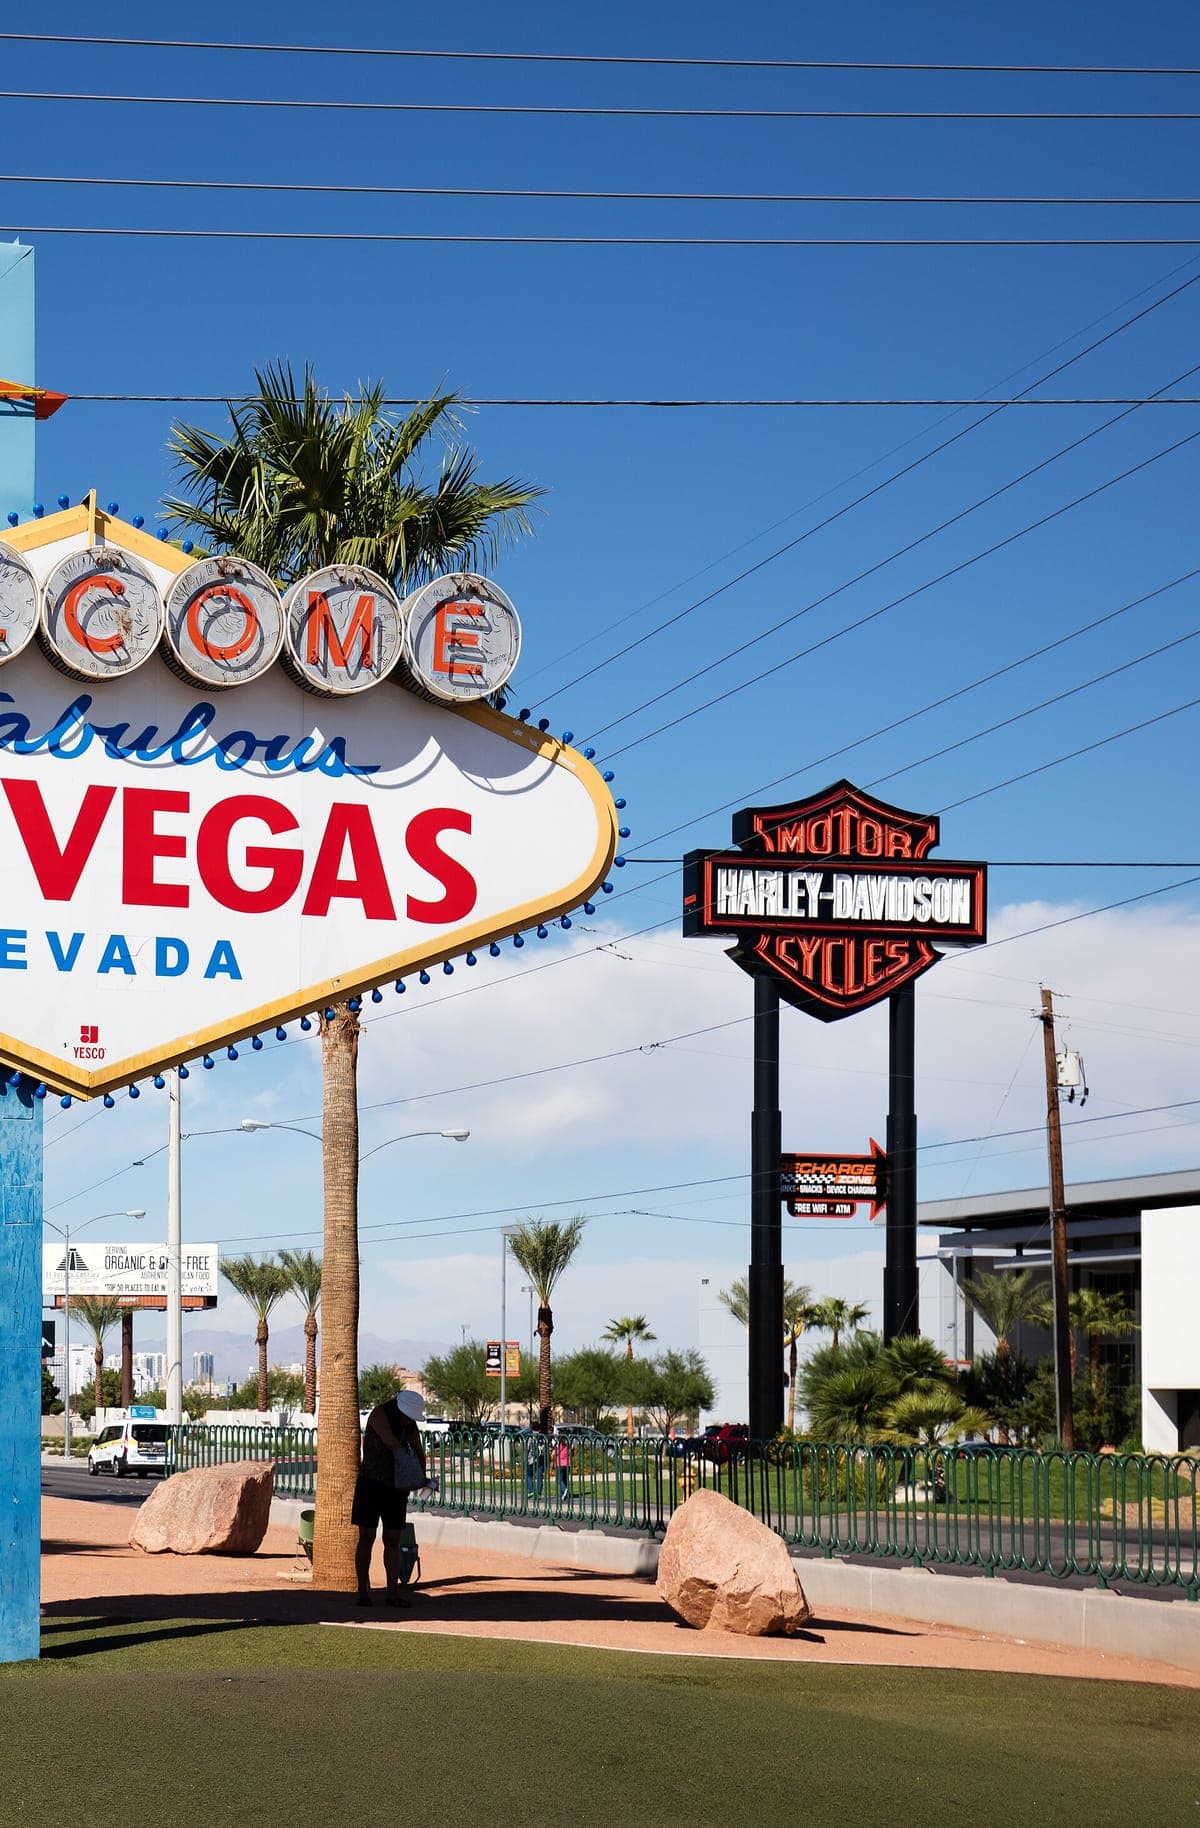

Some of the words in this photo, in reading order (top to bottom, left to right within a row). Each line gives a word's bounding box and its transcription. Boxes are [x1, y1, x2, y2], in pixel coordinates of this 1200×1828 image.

[777, 803, 913, 858] MOTOR
[0, 777, 478, 925] VEGAS
[717, 868, 971, 925] HARLEY-DAVIDSON
[775, 936, 910, 995] CYCLES
[73, 1046, 105, 1060] YESCO
[837, 1175, 873, 1184] ZONE
[800, 1185, 823, 1194] SNACKS
[826, 1186, 847, 1194] DEVICE
[848, 1186, 877, 1195] CHARGING
[794, 1203, 811, 1213] FREE
[835, 1204, 851, 1213] ATM
[105, 1246, 128, 1254] SERVING
[105, 1255, 146, 1270] ORGANIC
[149, 1255, 156, 1270] &
[195, 1271, 210, 1280] FOOD
